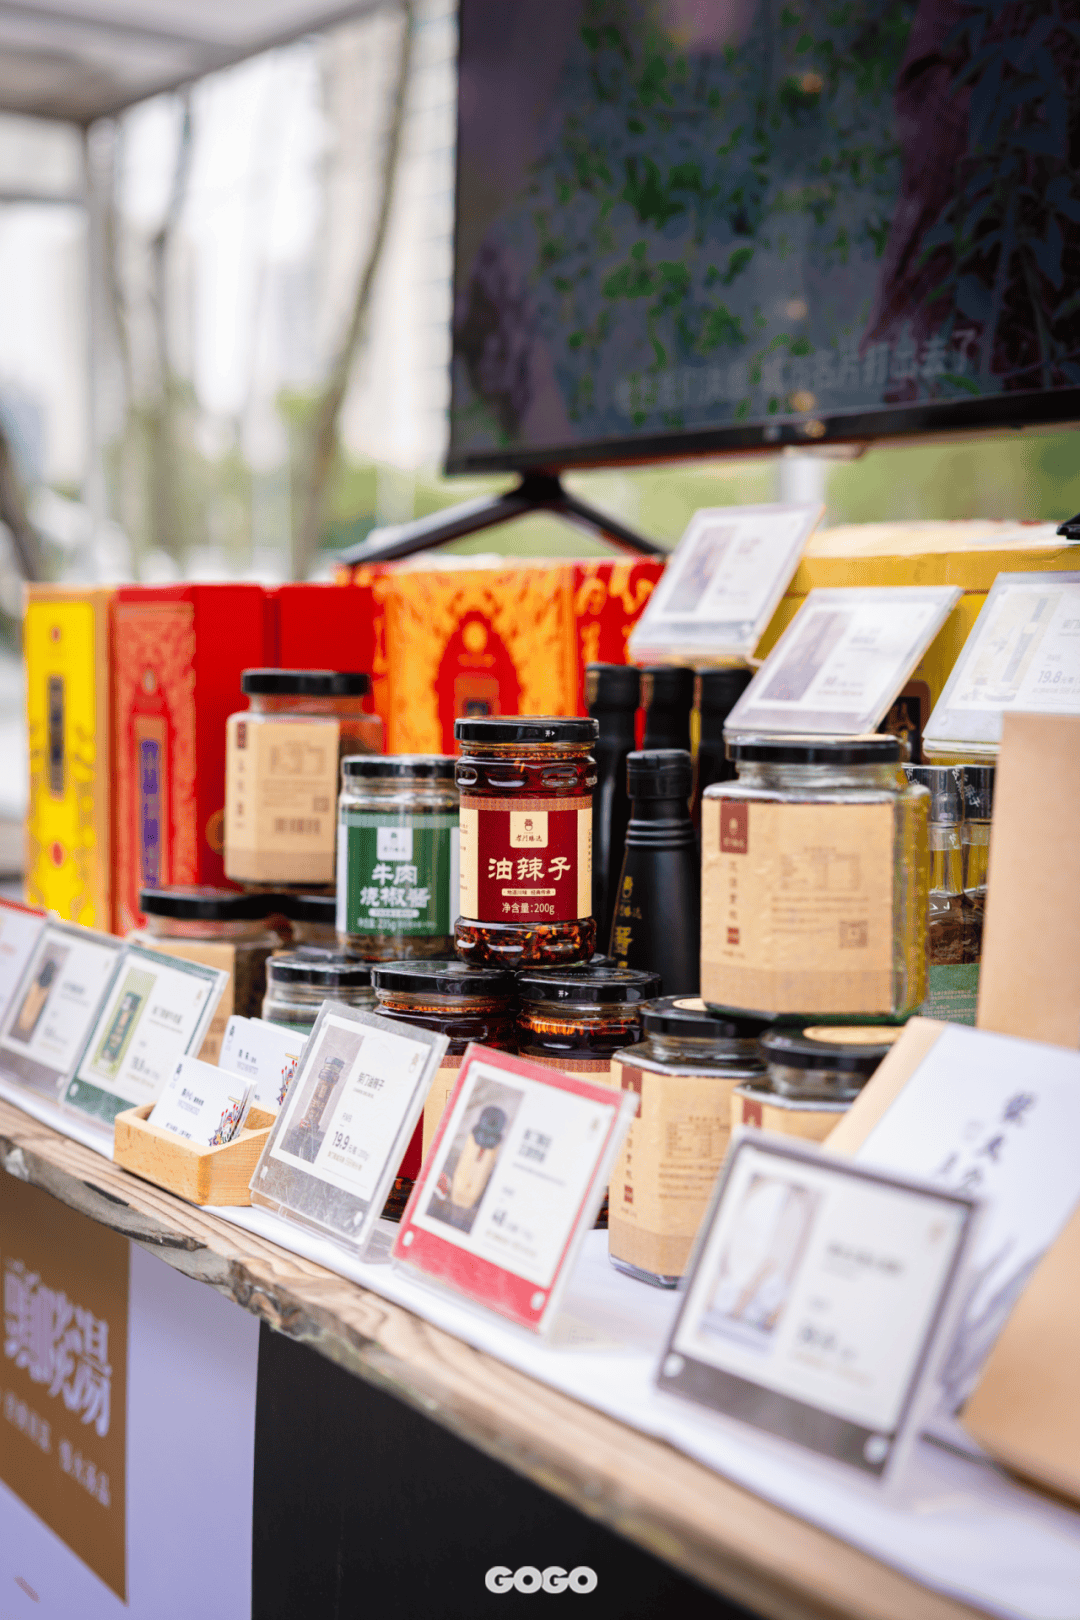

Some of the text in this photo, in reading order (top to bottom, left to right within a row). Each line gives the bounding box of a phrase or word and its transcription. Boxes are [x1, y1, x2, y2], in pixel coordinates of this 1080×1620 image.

[1038, 670, 1062, 684] 19.8
[371, 862, 418, 885] 牛肉
[488, 856, 571, 881] 油辣子
[501, 902, 555, 915] 净含量:200g
[331, 1130, 350, 1151] 19.9
